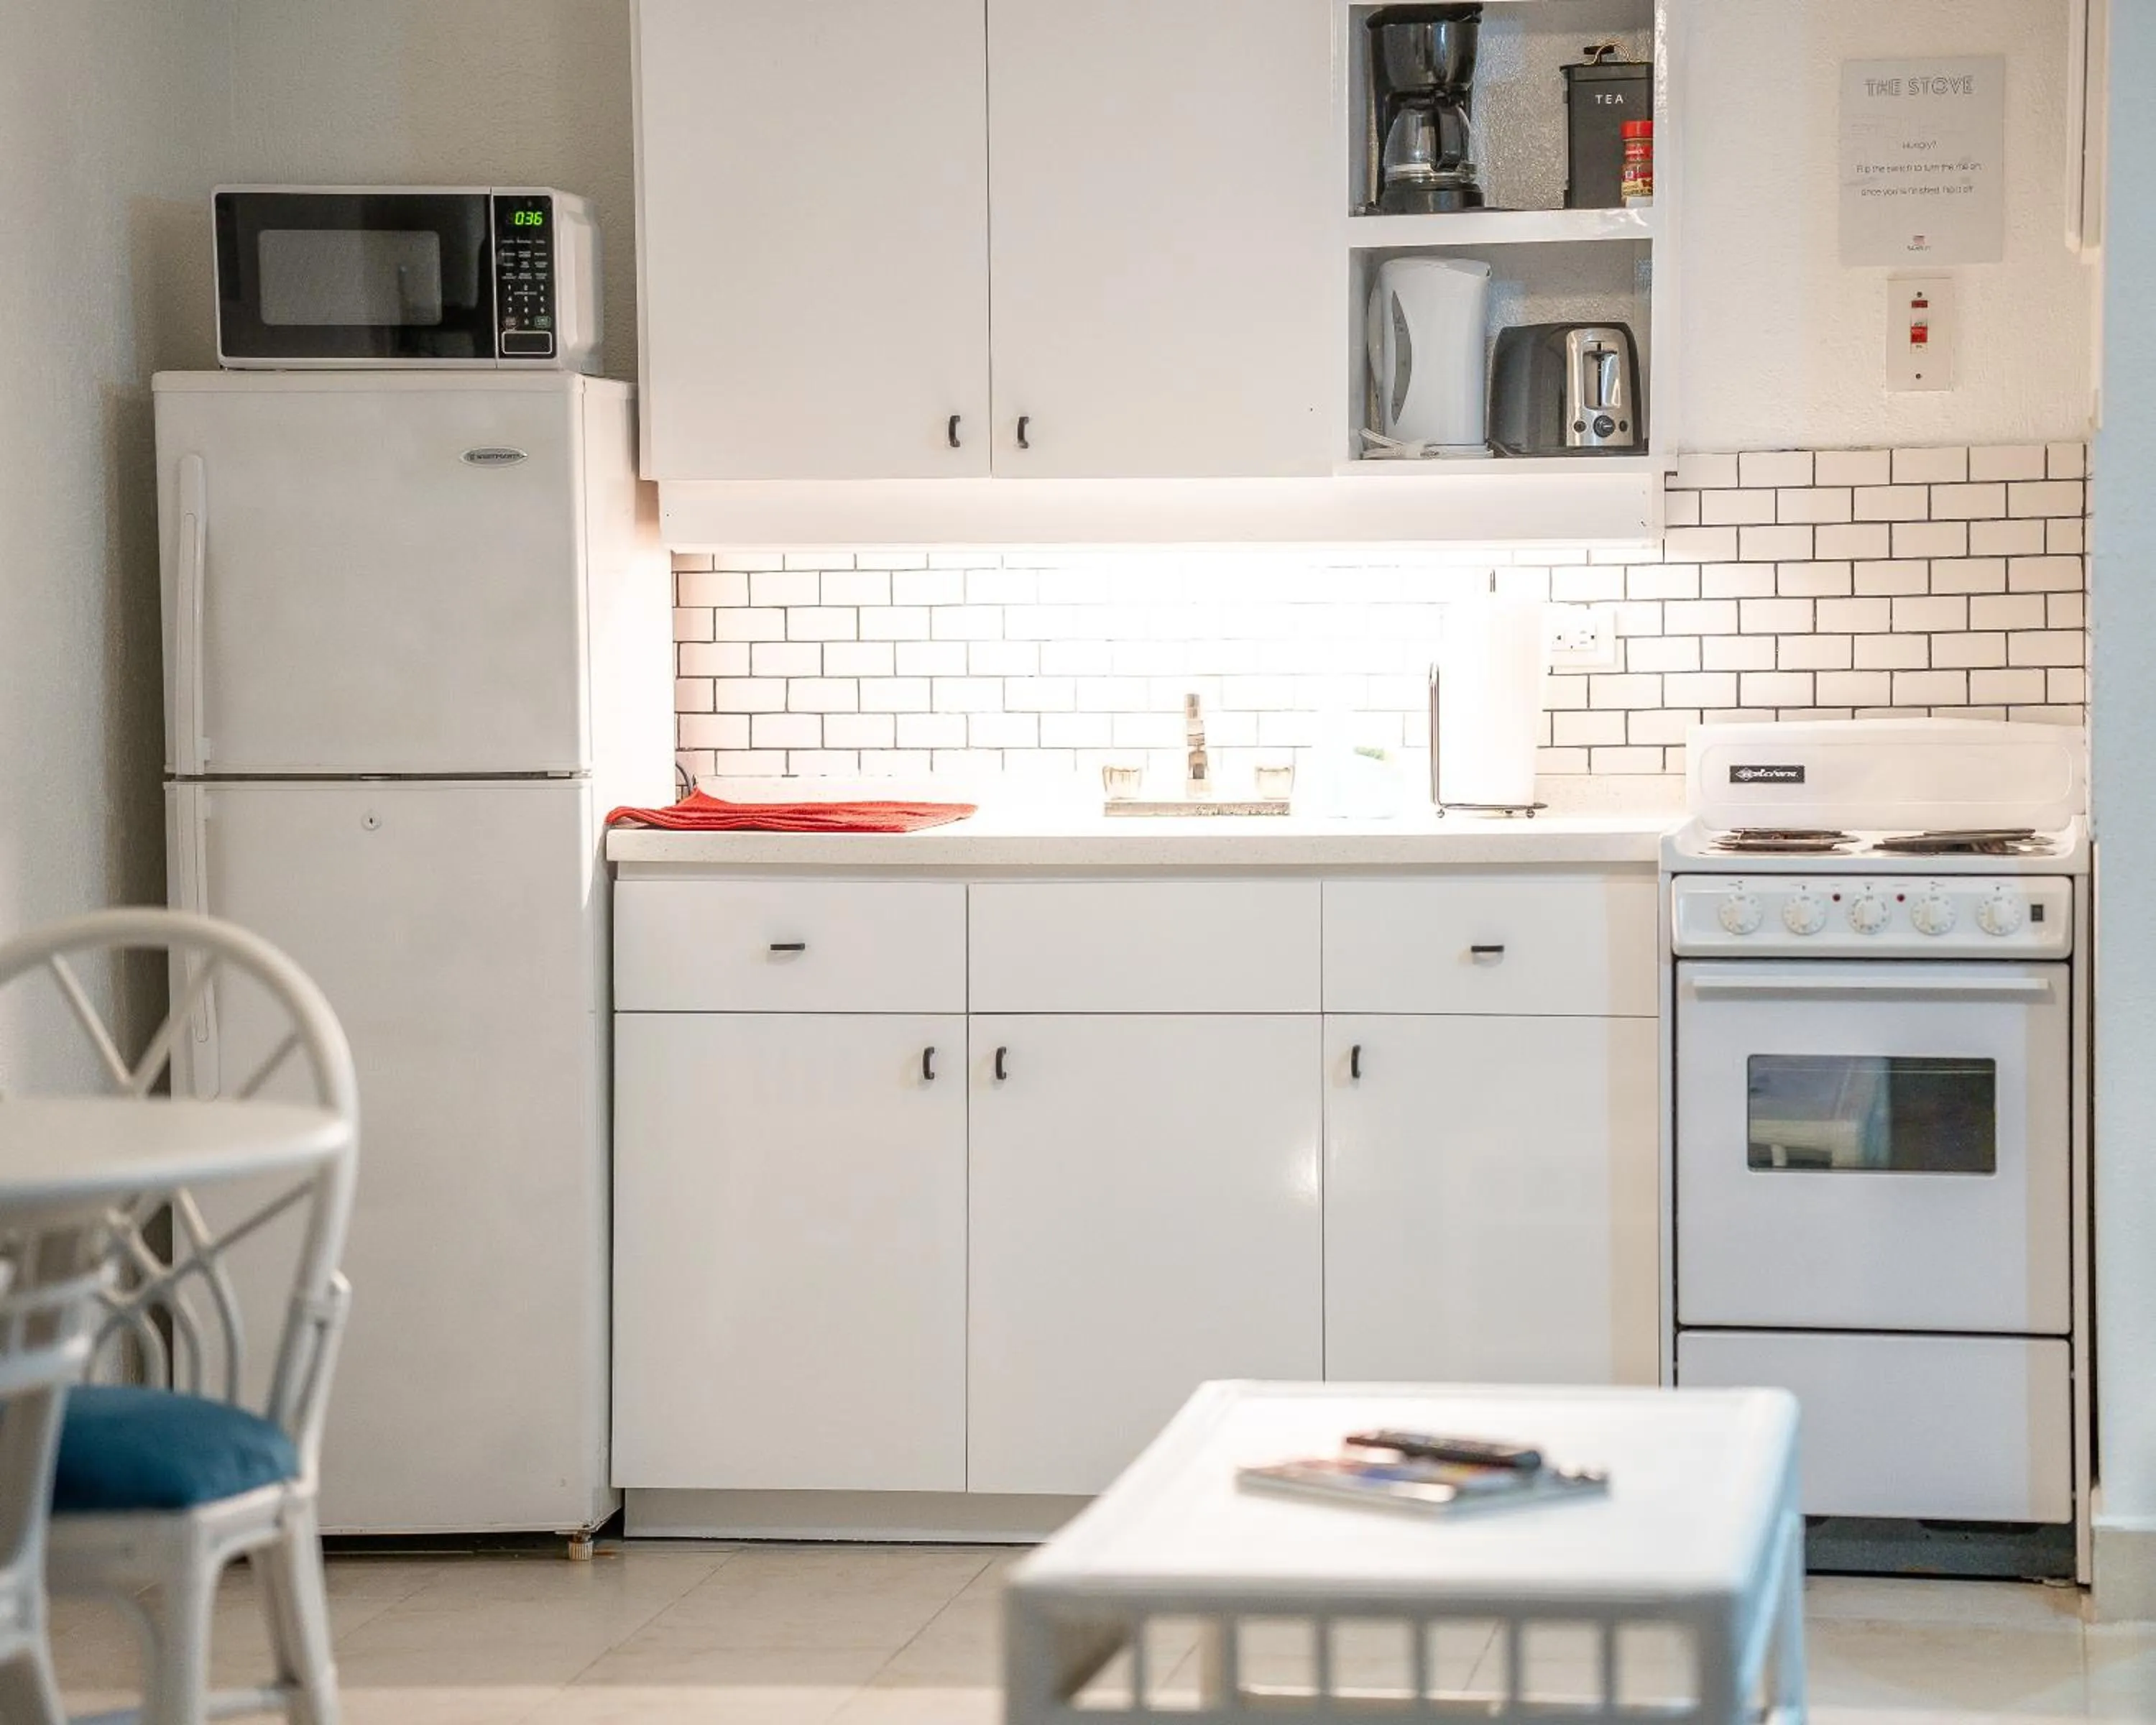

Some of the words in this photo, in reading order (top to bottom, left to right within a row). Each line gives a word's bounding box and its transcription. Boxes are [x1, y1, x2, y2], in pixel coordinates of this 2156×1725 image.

[1864, 78, 1902, 96] THE
[1908, 75, 1973, 95] STOVE
[1595, 94, 1623, 104] TEA
[515, 211, 543, 225] 036
